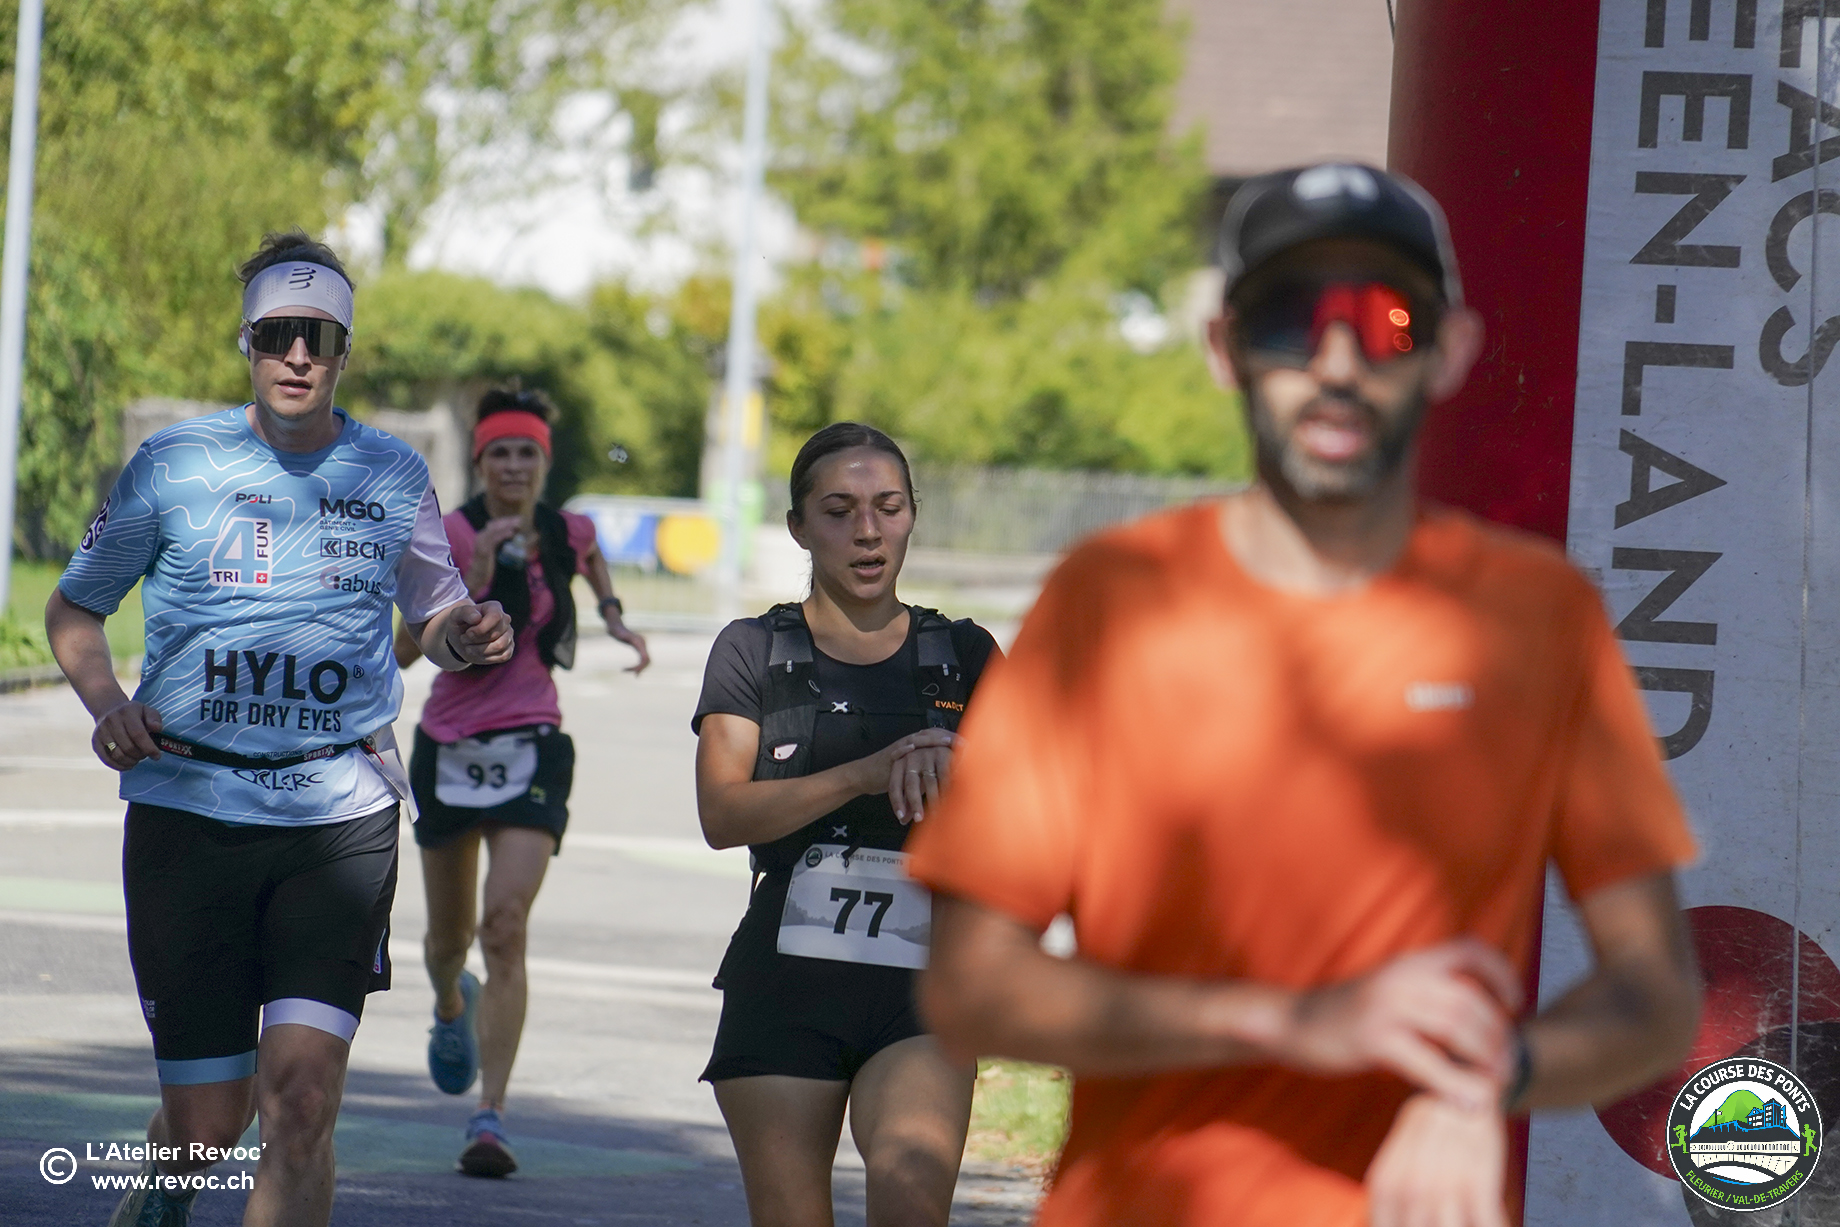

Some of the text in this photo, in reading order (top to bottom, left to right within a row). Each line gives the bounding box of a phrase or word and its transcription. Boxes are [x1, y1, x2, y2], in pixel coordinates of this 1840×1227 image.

[235, 493, 272, 504] POLI
[319, 498, 386, 522] MGO
[213, 521, 268, 583] 4
[256, 522, 268, 558] FUN
[346, 540, 385, 561] BCN
[213, 571, 239, 582] TRI
[200, 699, 341, 733] FOR DRY EYES
[466, 763, 507, 790] 93
[866, 855, 880, 863] DES
[829, 887, 894, 938] 77
